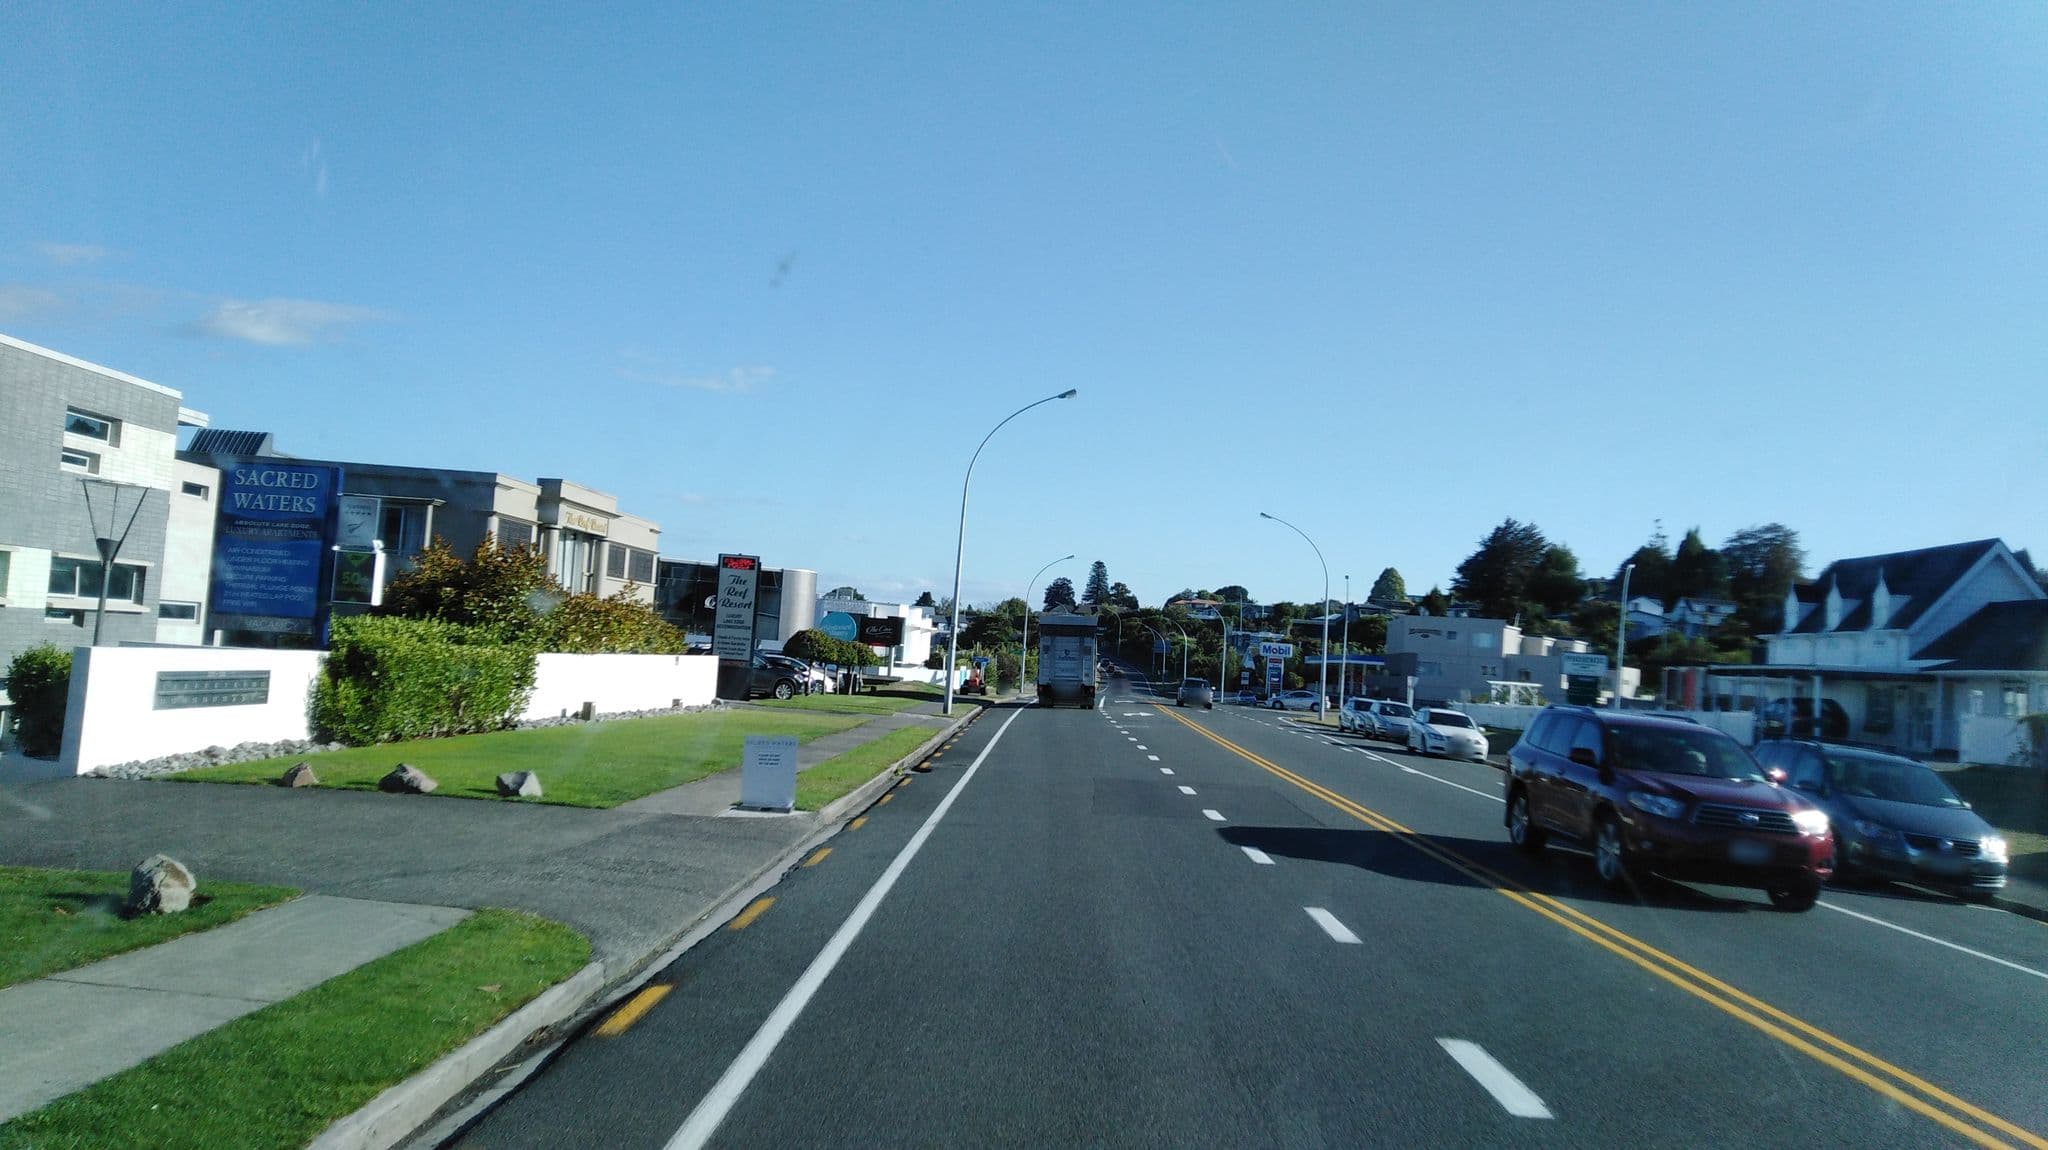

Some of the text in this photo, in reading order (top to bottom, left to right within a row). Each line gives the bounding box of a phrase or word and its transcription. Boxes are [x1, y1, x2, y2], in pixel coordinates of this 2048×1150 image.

[234, 468, 319, 489] SACRED
[233, 492, 317, 513] WATERS
[262, 527, 318, 538] APARTMENTS
[728, 574, 748, 585] The
[724, 586, 749, 600] Reef
[719, 597, 753, 609] Resort
[1262, 644, 1290, 655] Mobil
